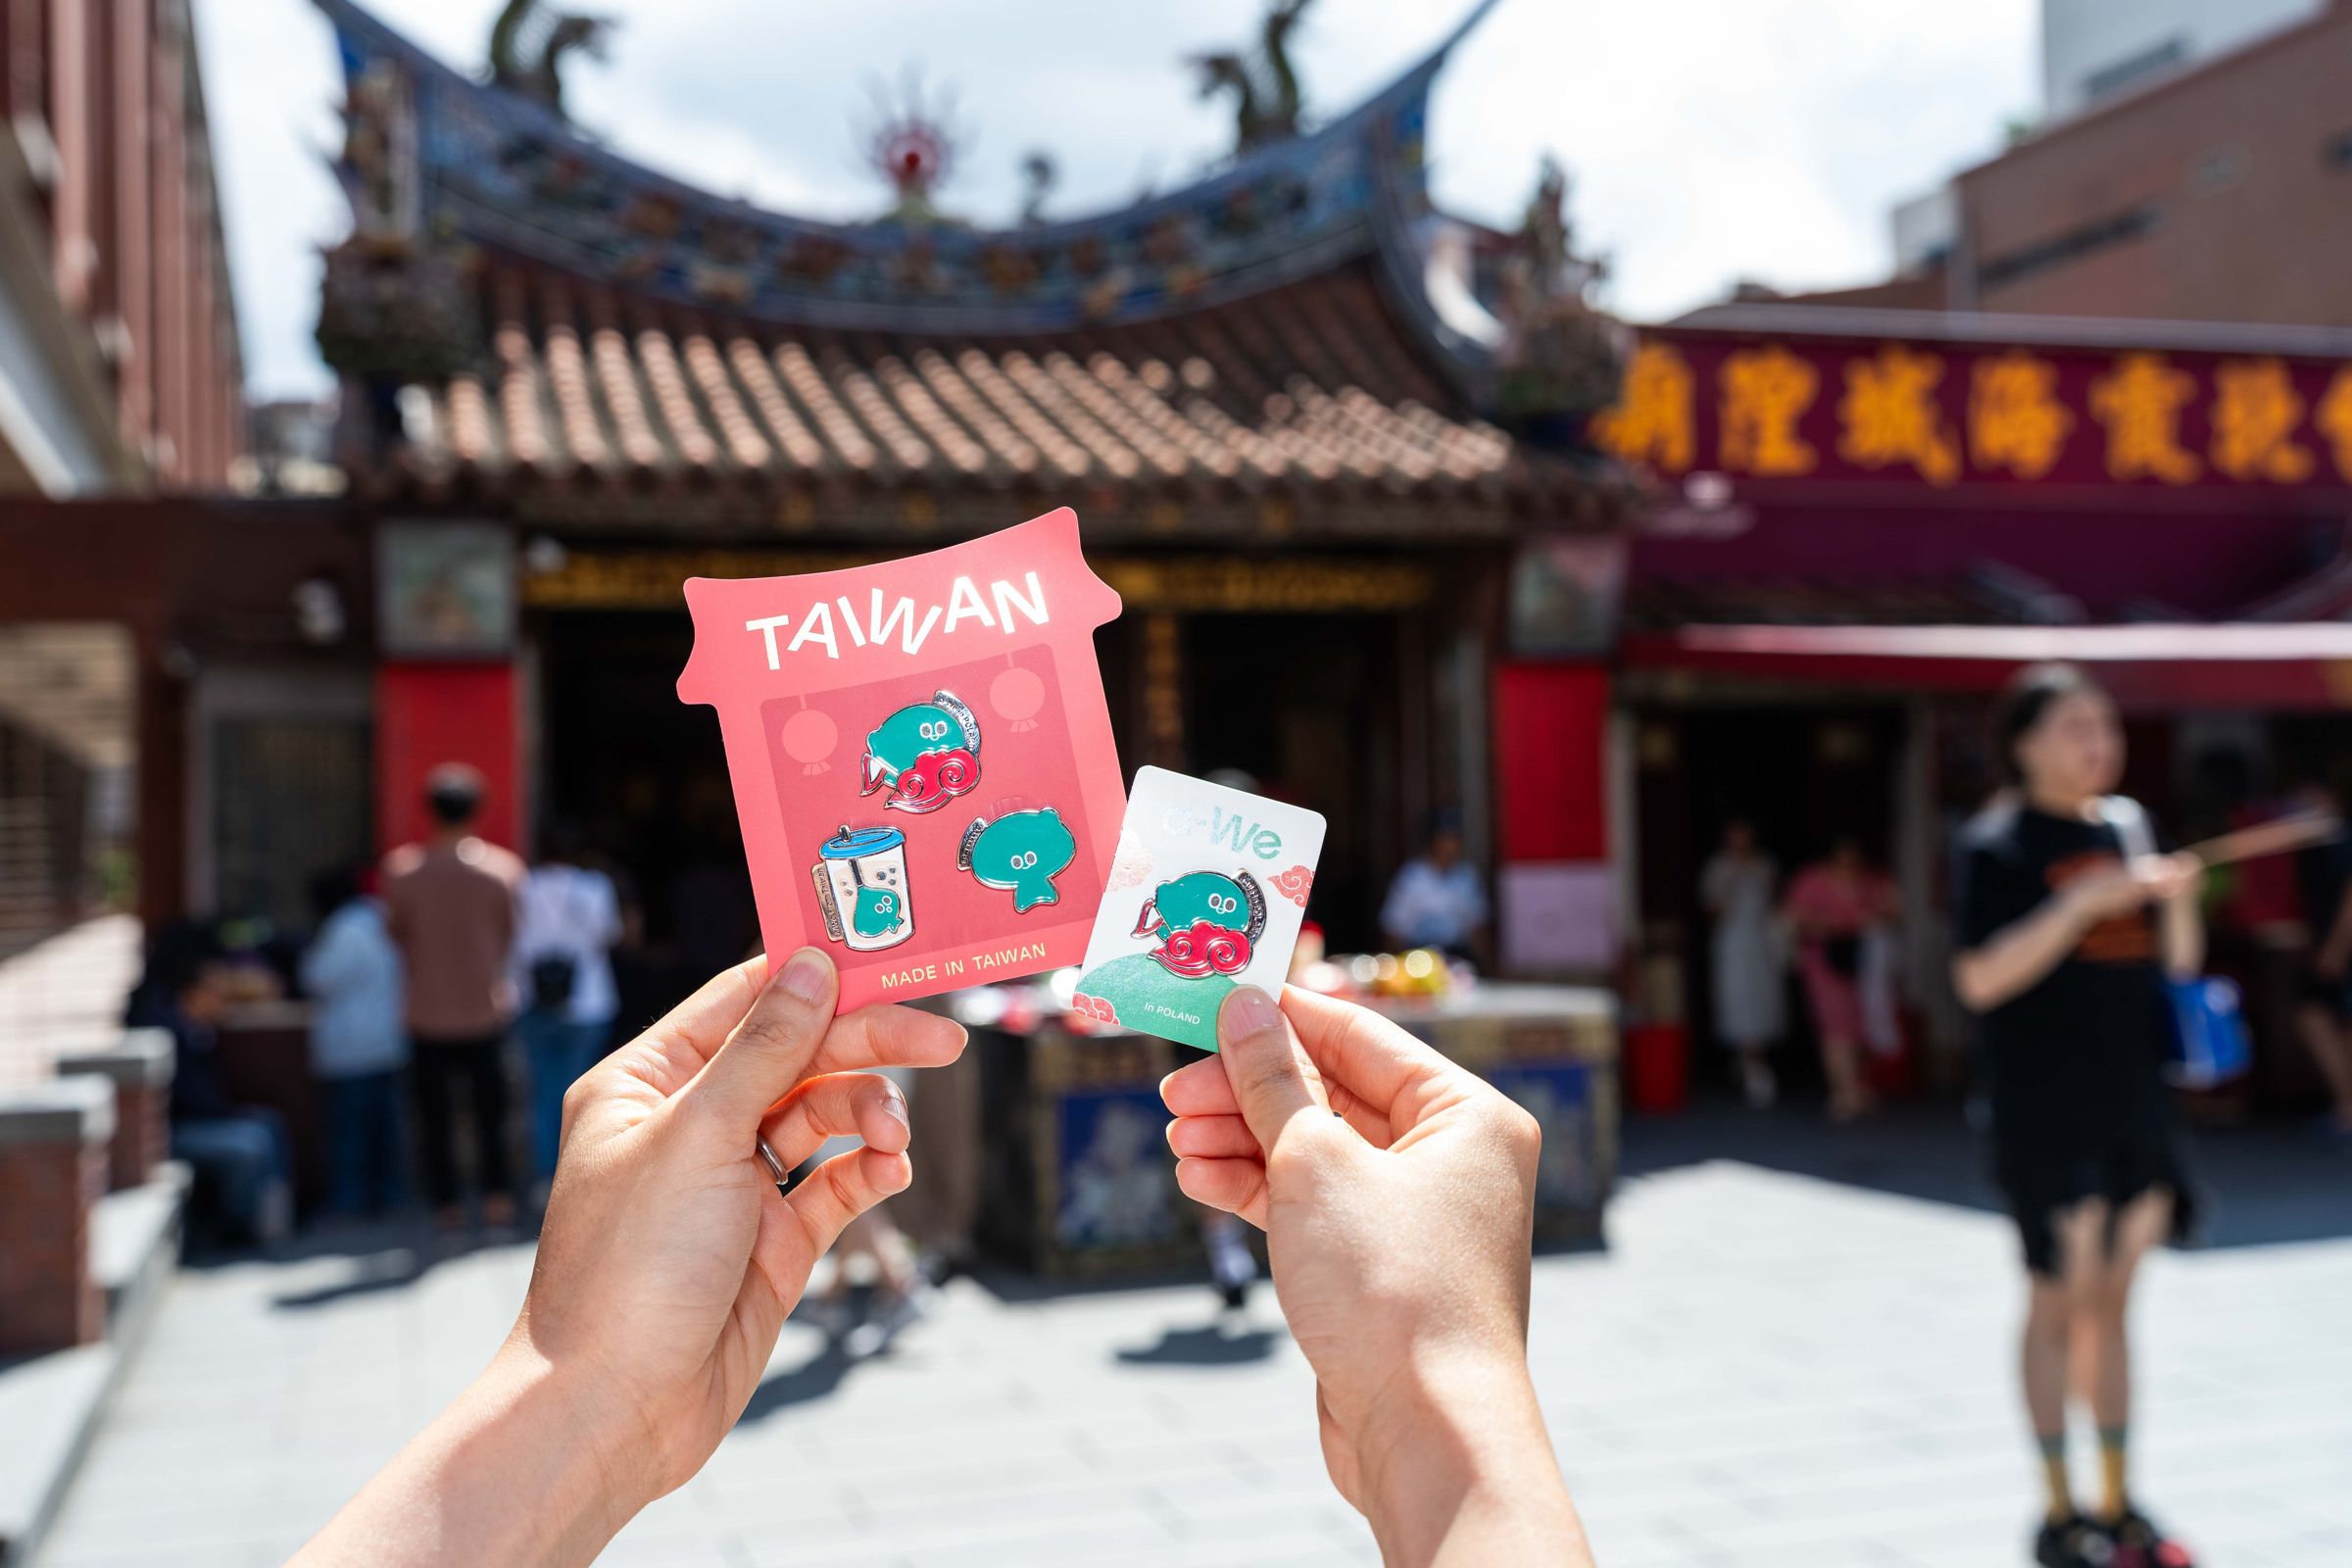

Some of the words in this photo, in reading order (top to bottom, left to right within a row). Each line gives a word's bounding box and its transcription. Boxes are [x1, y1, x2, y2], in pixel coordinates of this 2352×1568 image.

[746, 571, 1050, 670] TAIWAN
[881, 964, 938, 989] MADE
[944, 959, 965, 977] IN
[972, 943, 1047, 970] TAIWAN
[1156, 1005, 1200, 1025] POLAND
